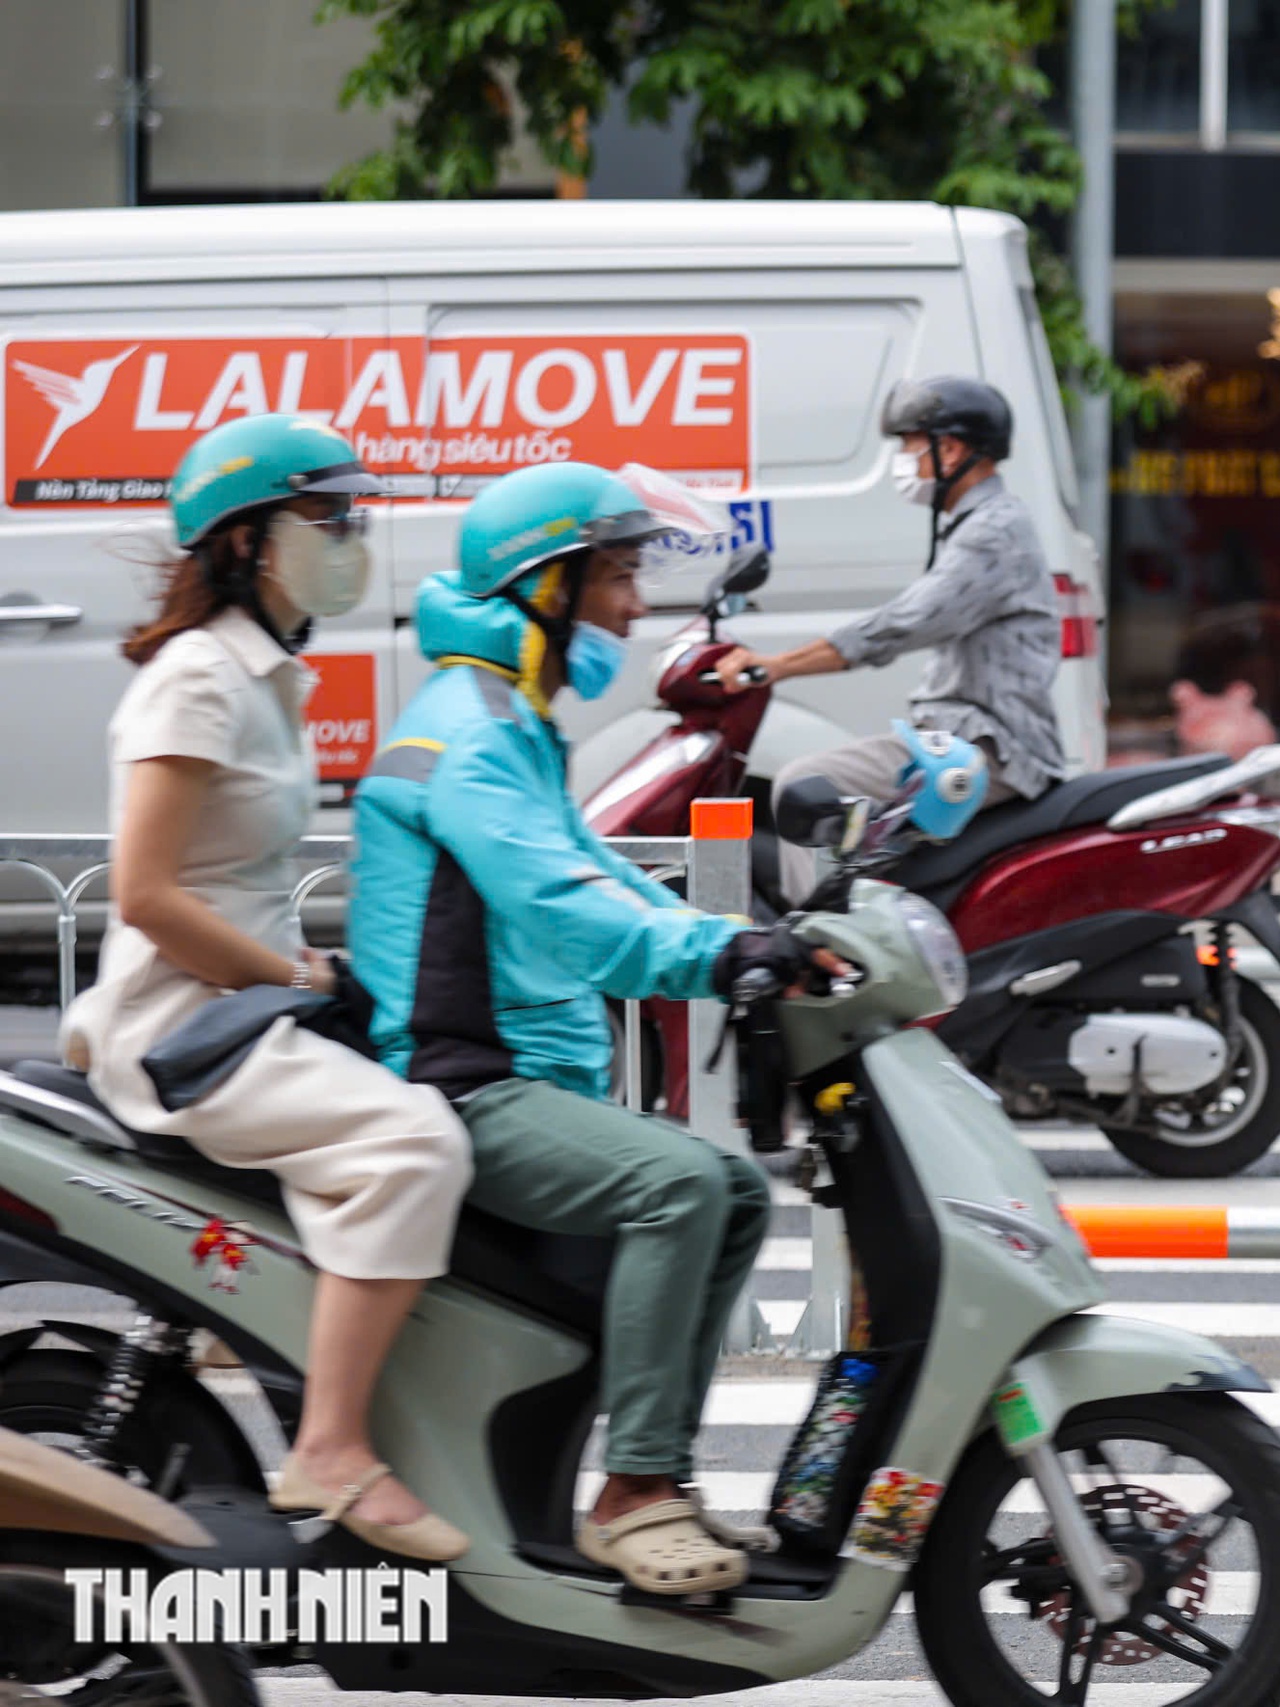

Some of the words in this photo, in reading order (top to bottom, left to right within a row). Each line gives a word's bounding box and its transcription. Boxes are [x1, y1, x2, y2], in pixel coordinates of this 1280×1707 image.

[134, 347, 743, 430] LALAMOVE
[356, 430, 442, 471] hàng
[514, 428, 572, 463] tốc
